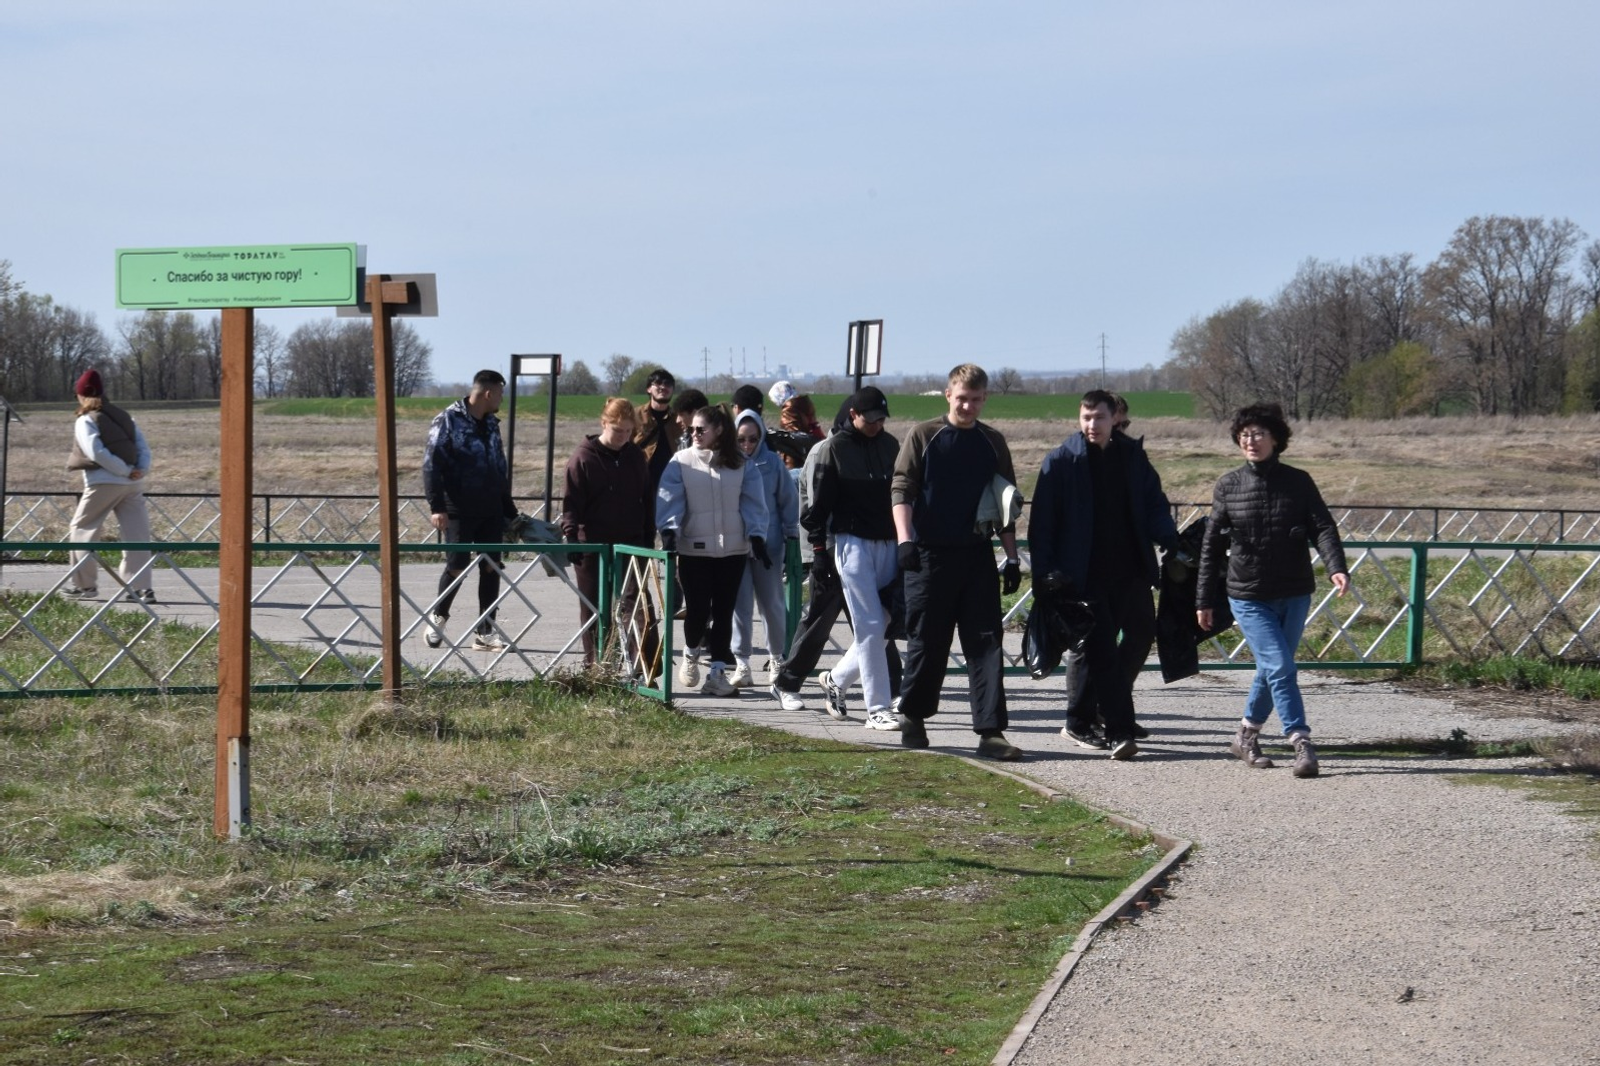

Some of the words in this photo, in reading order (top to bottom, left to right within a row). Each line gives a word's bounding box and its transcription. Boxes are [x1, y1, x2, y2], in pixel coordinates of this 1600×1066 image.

[167, 270, 213, 283] Спасибо
[216, 271, 228, 281] за
[231, 270, 272, 284] чистую
[275, 268, 302, 283] гору!
